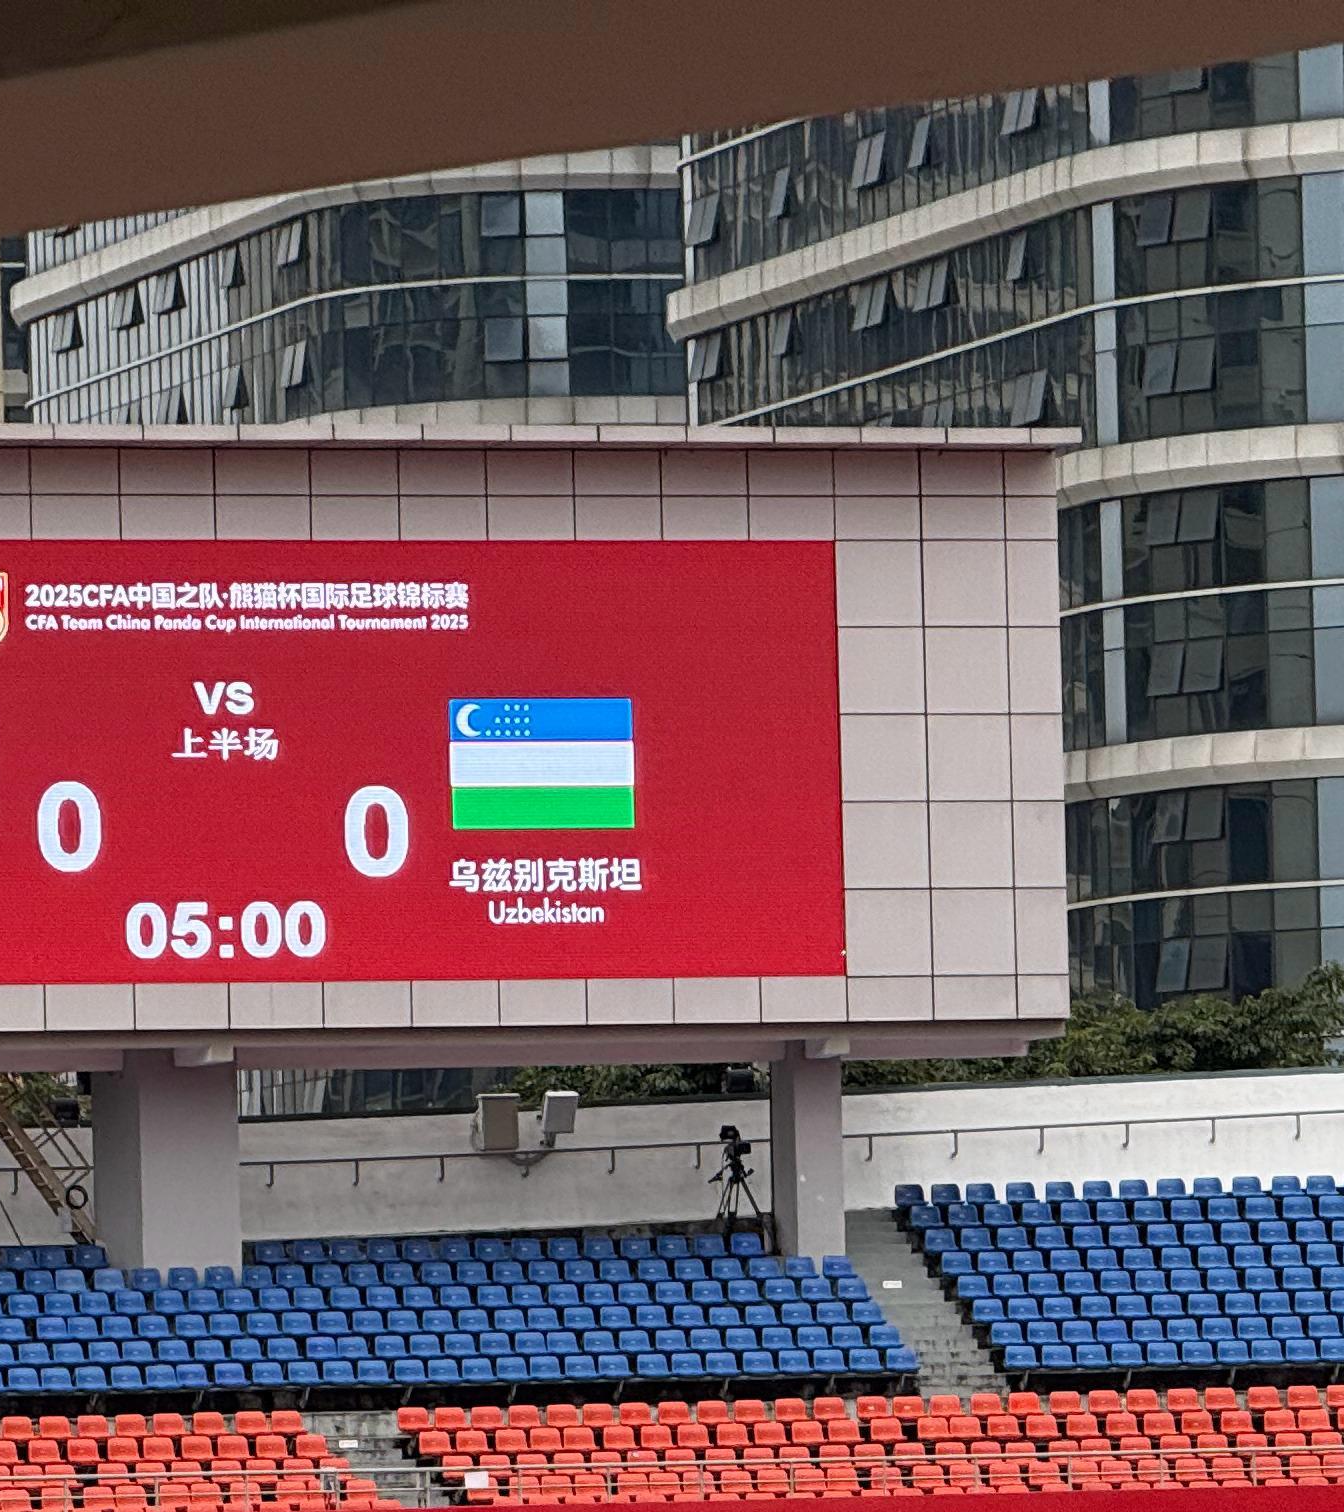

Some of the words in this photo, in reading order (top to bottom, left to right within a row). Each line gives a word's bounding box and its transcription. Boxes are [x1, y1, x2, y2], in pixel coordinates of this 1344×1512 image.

[25, 582, 469, 610] 2025CFA中国之队·熊猫杯国际足球锦标赛
[25, 614, 58, 631] CFA
[61, 614, 103, 631] Team
[106, 613, 151, 631] China
[155, 614, 202, 631] Panda
[206, 614, 237, 633] Cup
[240, 613, 336, 631] International
[337, 614, 427, 631] Tournament
[431, 613, 469, 631] 2025
[193, 681, 255, 715] VS
[171, 727, 280, 761] 上半场
[37, 781, 102, 873] 0
[344, 785, 409, 877] 0
[449, 857, 643, 892] 乌兹别克斯坦
[488, 897, 605, 924] Uzbekistan
[125, 900, 326, 959] 05:00
